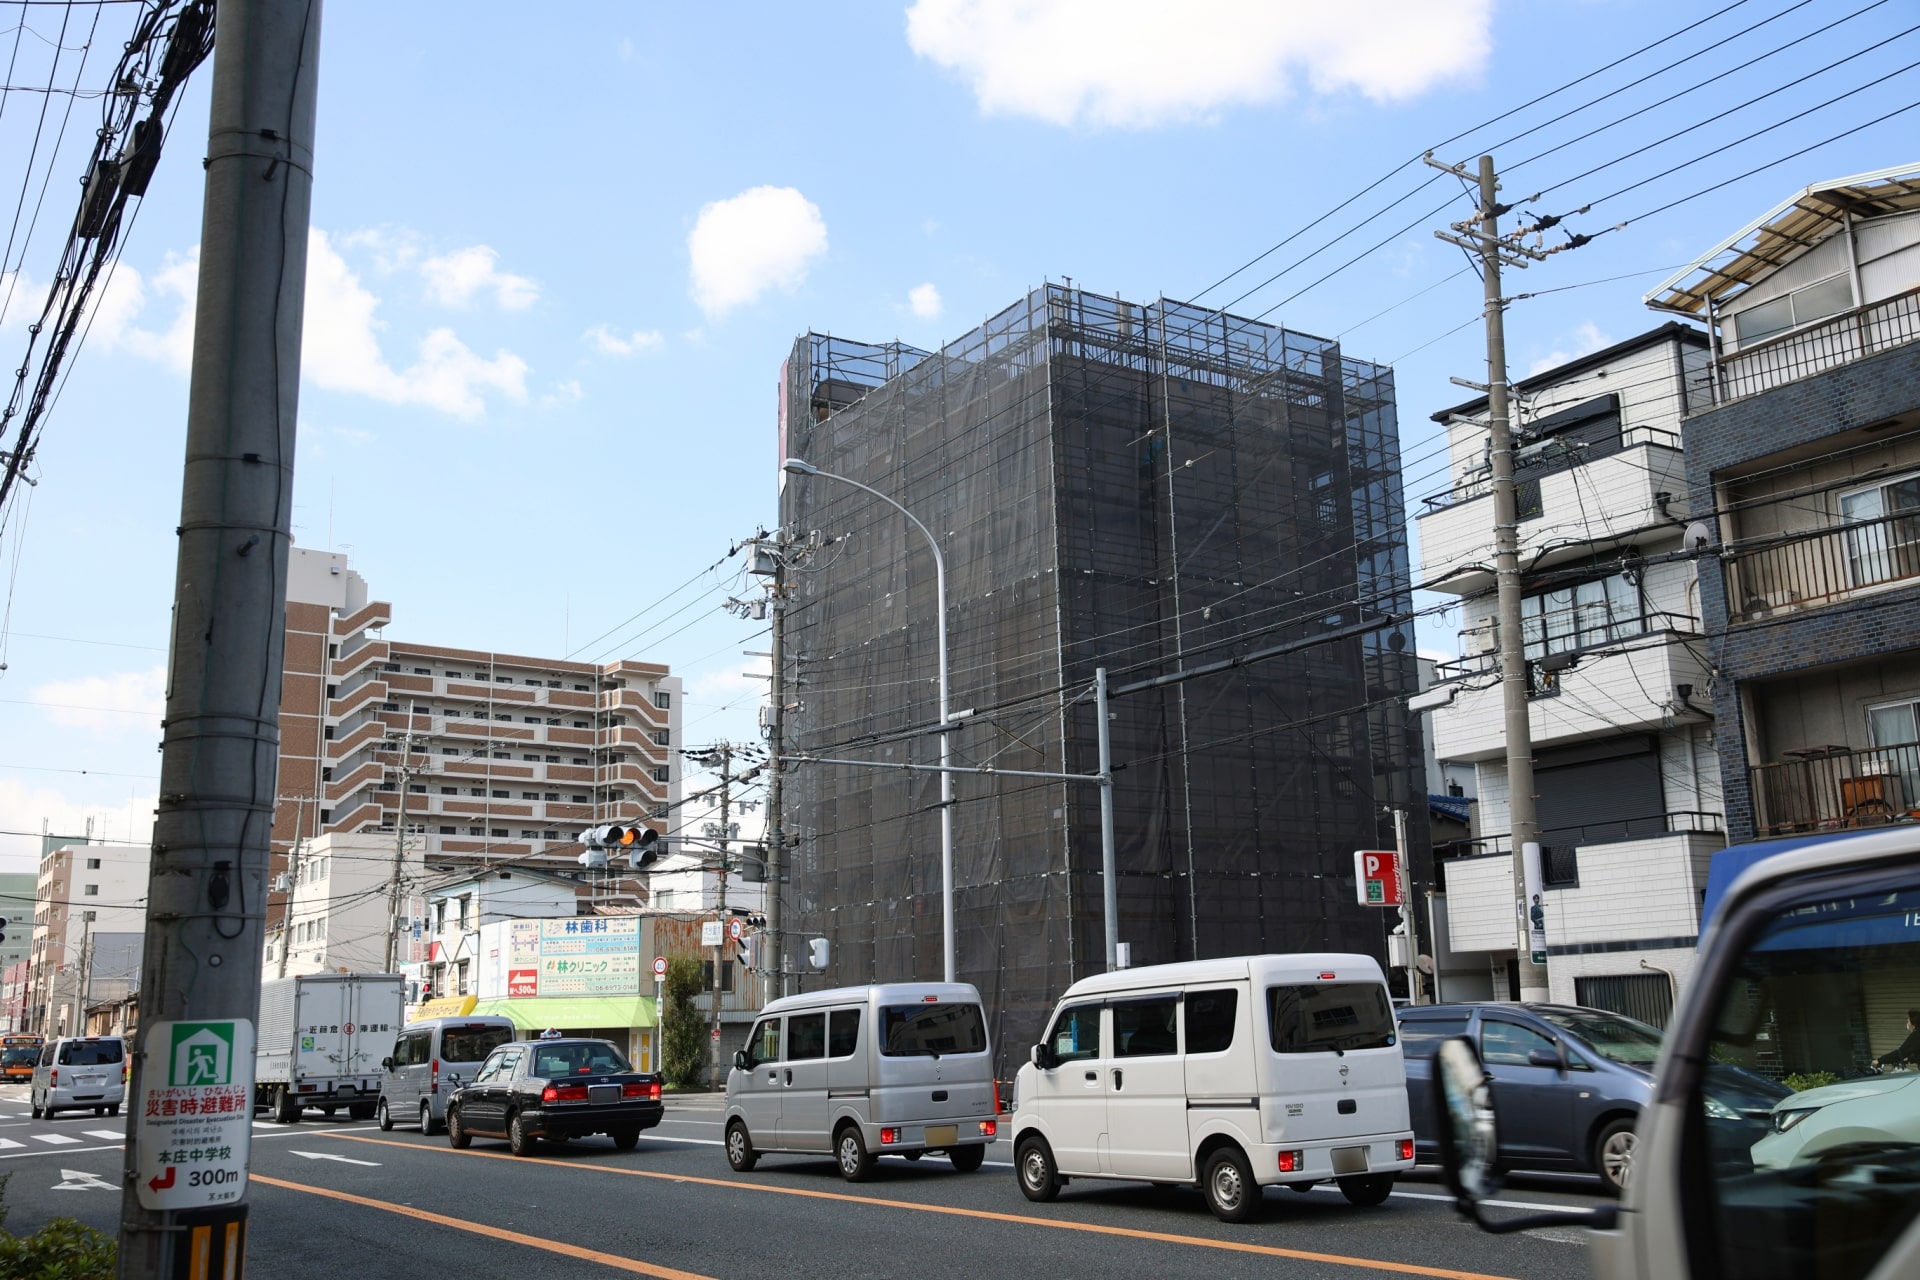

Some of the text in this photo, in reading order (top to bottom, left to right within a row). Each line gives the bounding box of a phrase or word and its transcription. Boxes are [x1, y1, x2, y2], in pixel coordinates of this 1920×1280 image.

[1366, 856, 1379, 877] P
[565, 919, 608, 934] 林歯科
[557, 960, 608, 974] 林クリニック
[656, 962, 665, 970] 40
[149, 1084, 246, 1098] さいがいじ ひなんじょ
[145, 1094, 246, 1117] 災害時避難所
[179, 1117, 205, 1125] Disaster
[158, 1145, 232, 1164] 本庄中学校
[188, 1168, 239, 1187] 300m
